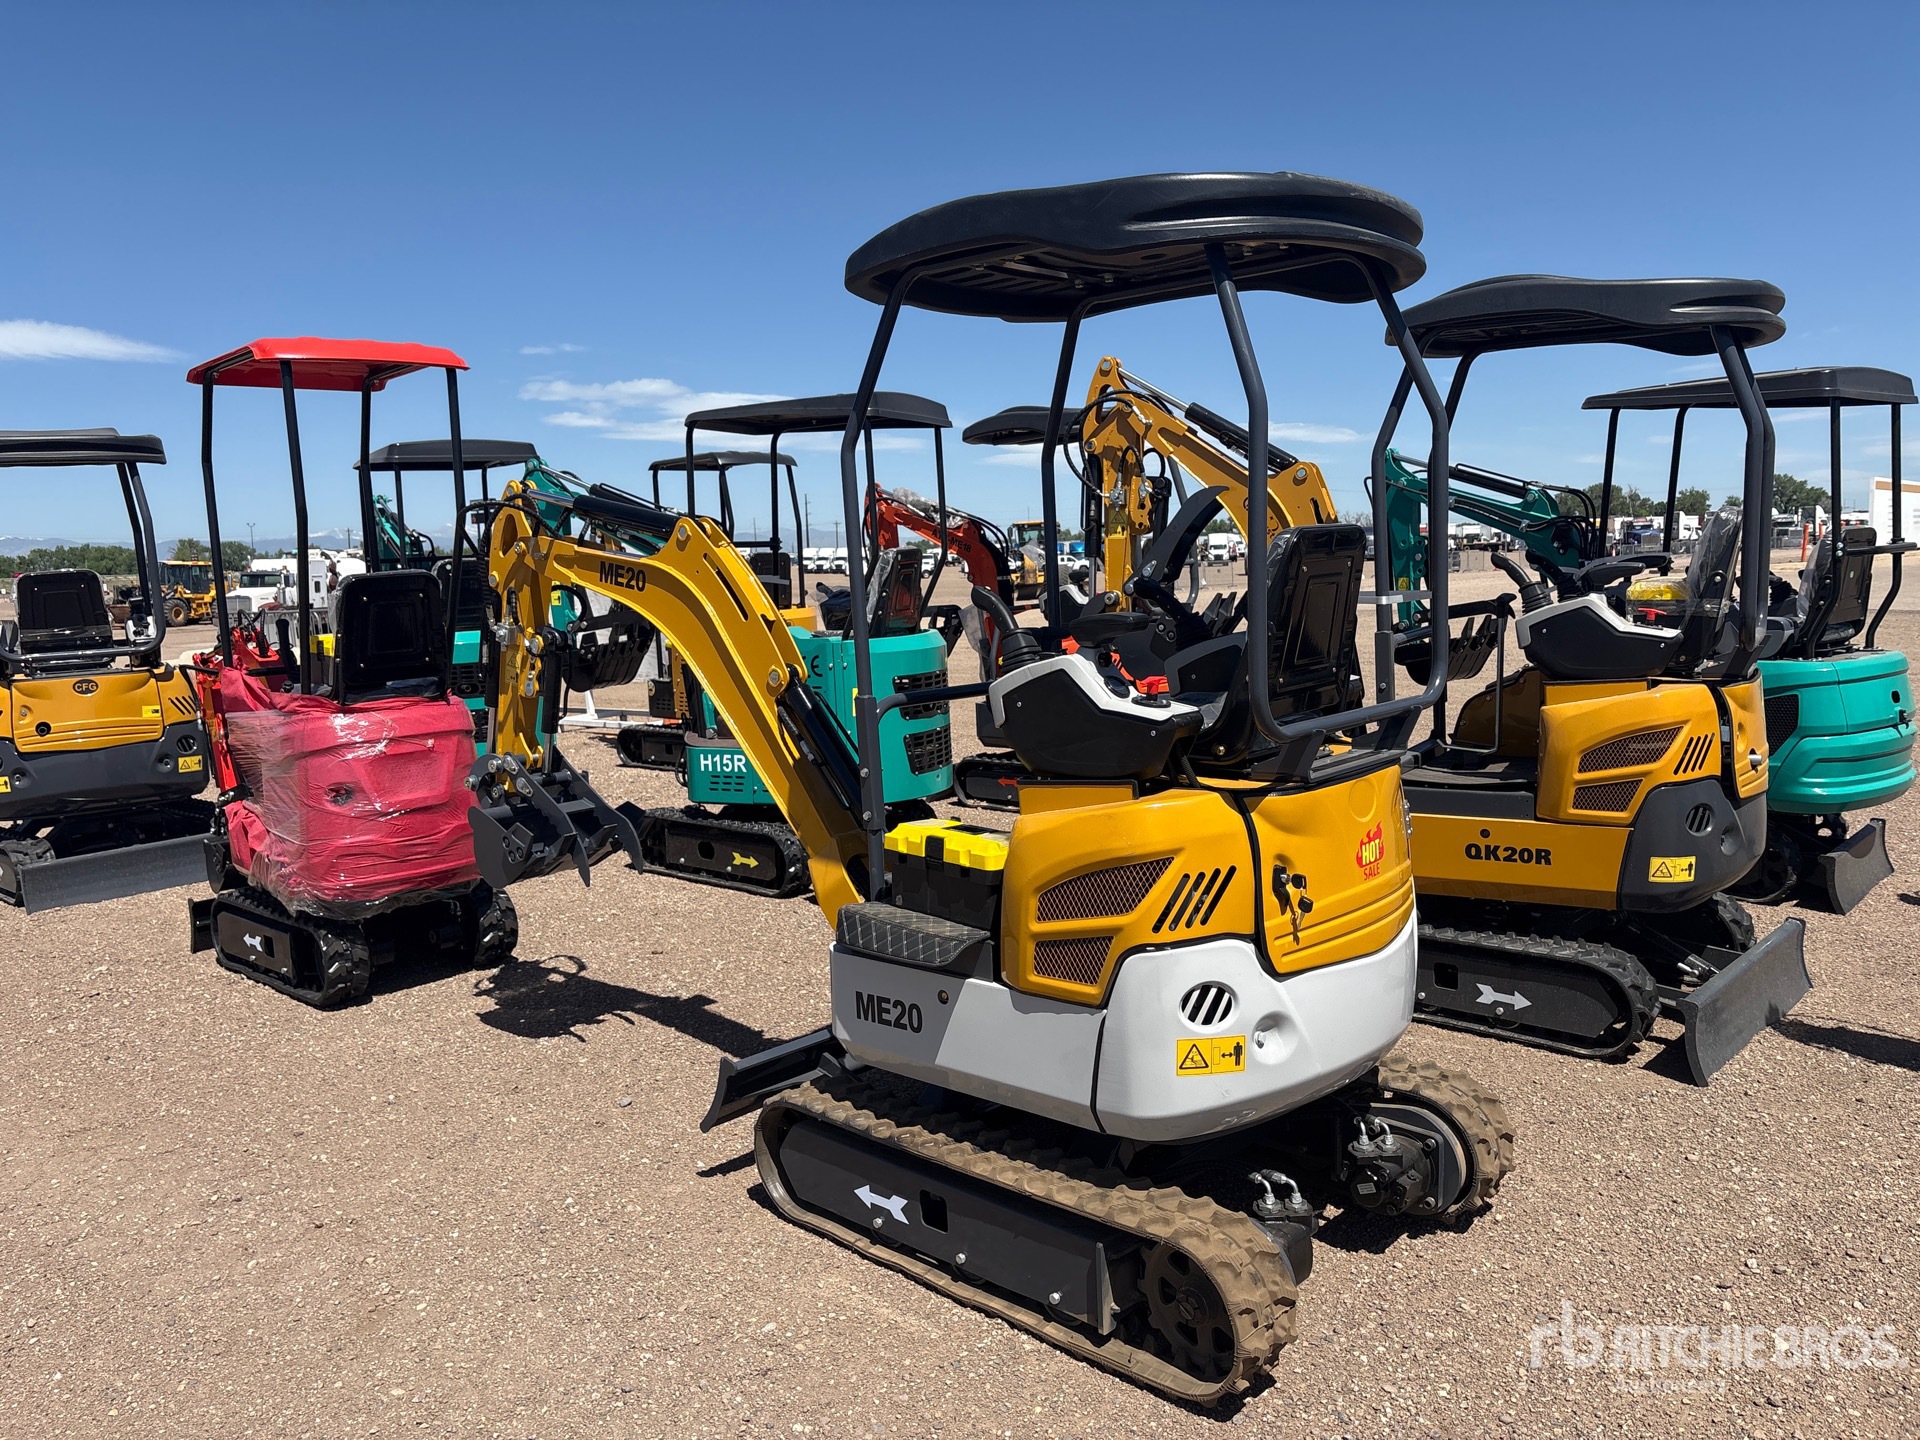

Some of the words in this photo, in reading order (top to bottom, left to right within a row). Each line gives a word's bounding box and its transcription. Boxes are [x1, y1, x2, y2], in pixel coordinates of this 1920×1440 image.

[600, 560, 646, 592] ME20
[74, 682, 97, 692] CFG
[699, 753, 748, 773] H15R
[1361, 838, 1380, 866] HOT
[1464, 843, 1552, 866] QK20R
[1363, 862, 1380, 881] SALE
[855, 990, 923, 1034] ME20
